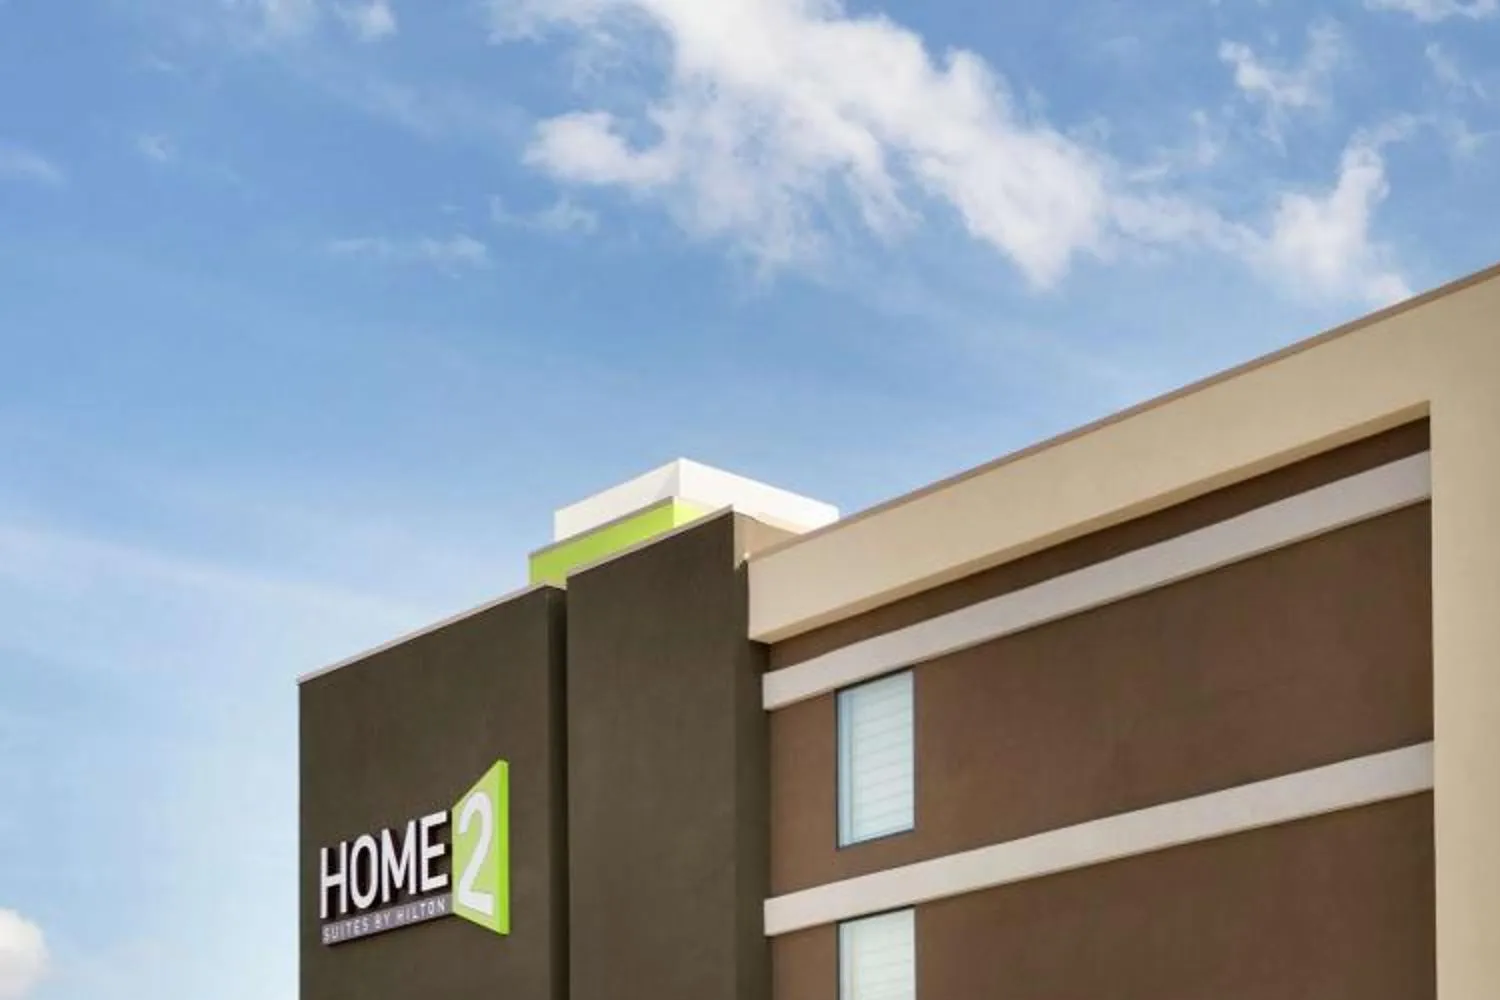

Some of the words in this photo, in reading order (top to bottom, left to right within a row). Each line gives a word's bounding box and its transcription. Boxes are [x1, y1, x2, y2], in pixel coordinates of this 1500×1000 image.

[319, 809, 449, 919] HOME
[458, 790, 495, 917] 2
[322, 916, 370, 945] SUITES
[375, 911, 391, 930] BY
[396, 897, 447, 922] HILTON
